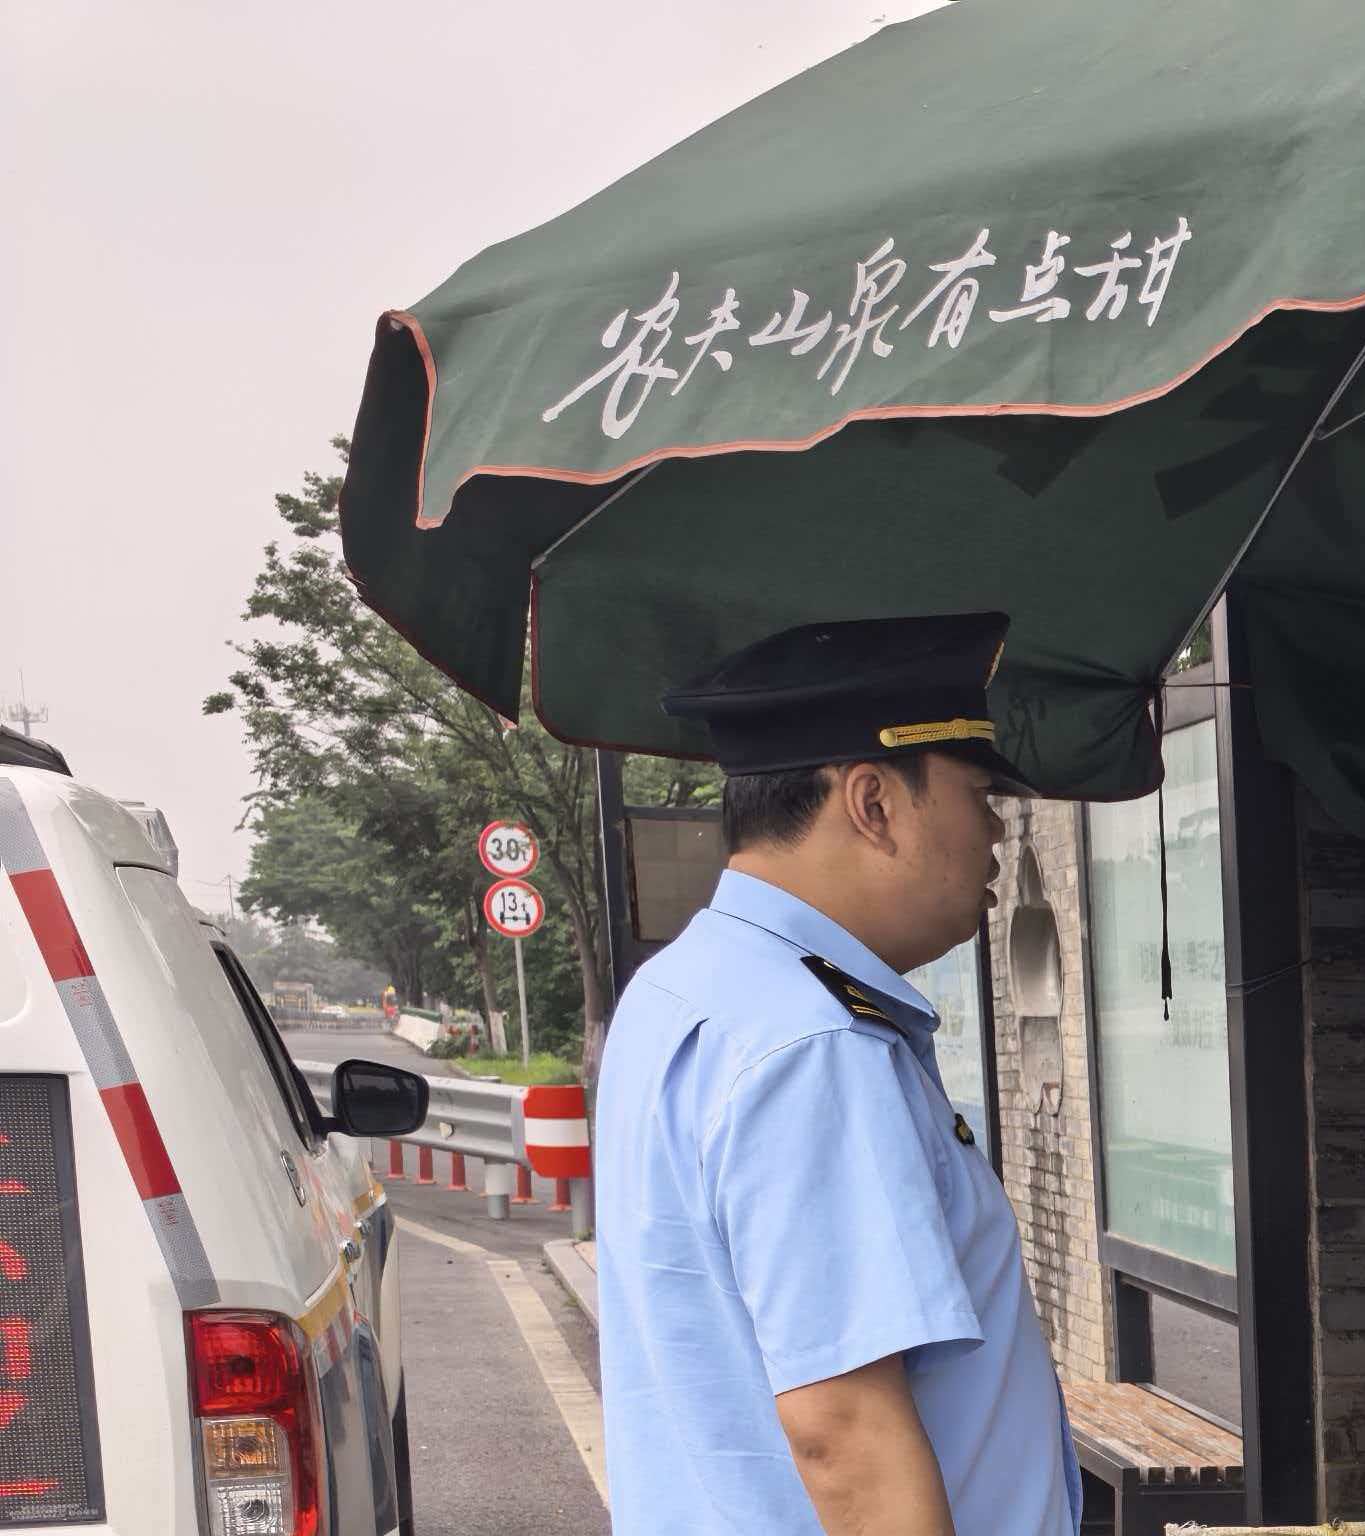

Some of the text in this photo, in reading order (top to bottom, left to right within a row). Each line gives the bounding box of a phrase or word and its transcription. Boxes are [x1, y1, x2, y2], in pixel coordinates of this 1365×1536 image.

[542, 217, 1192, 439] 农夫山泉有点甜
